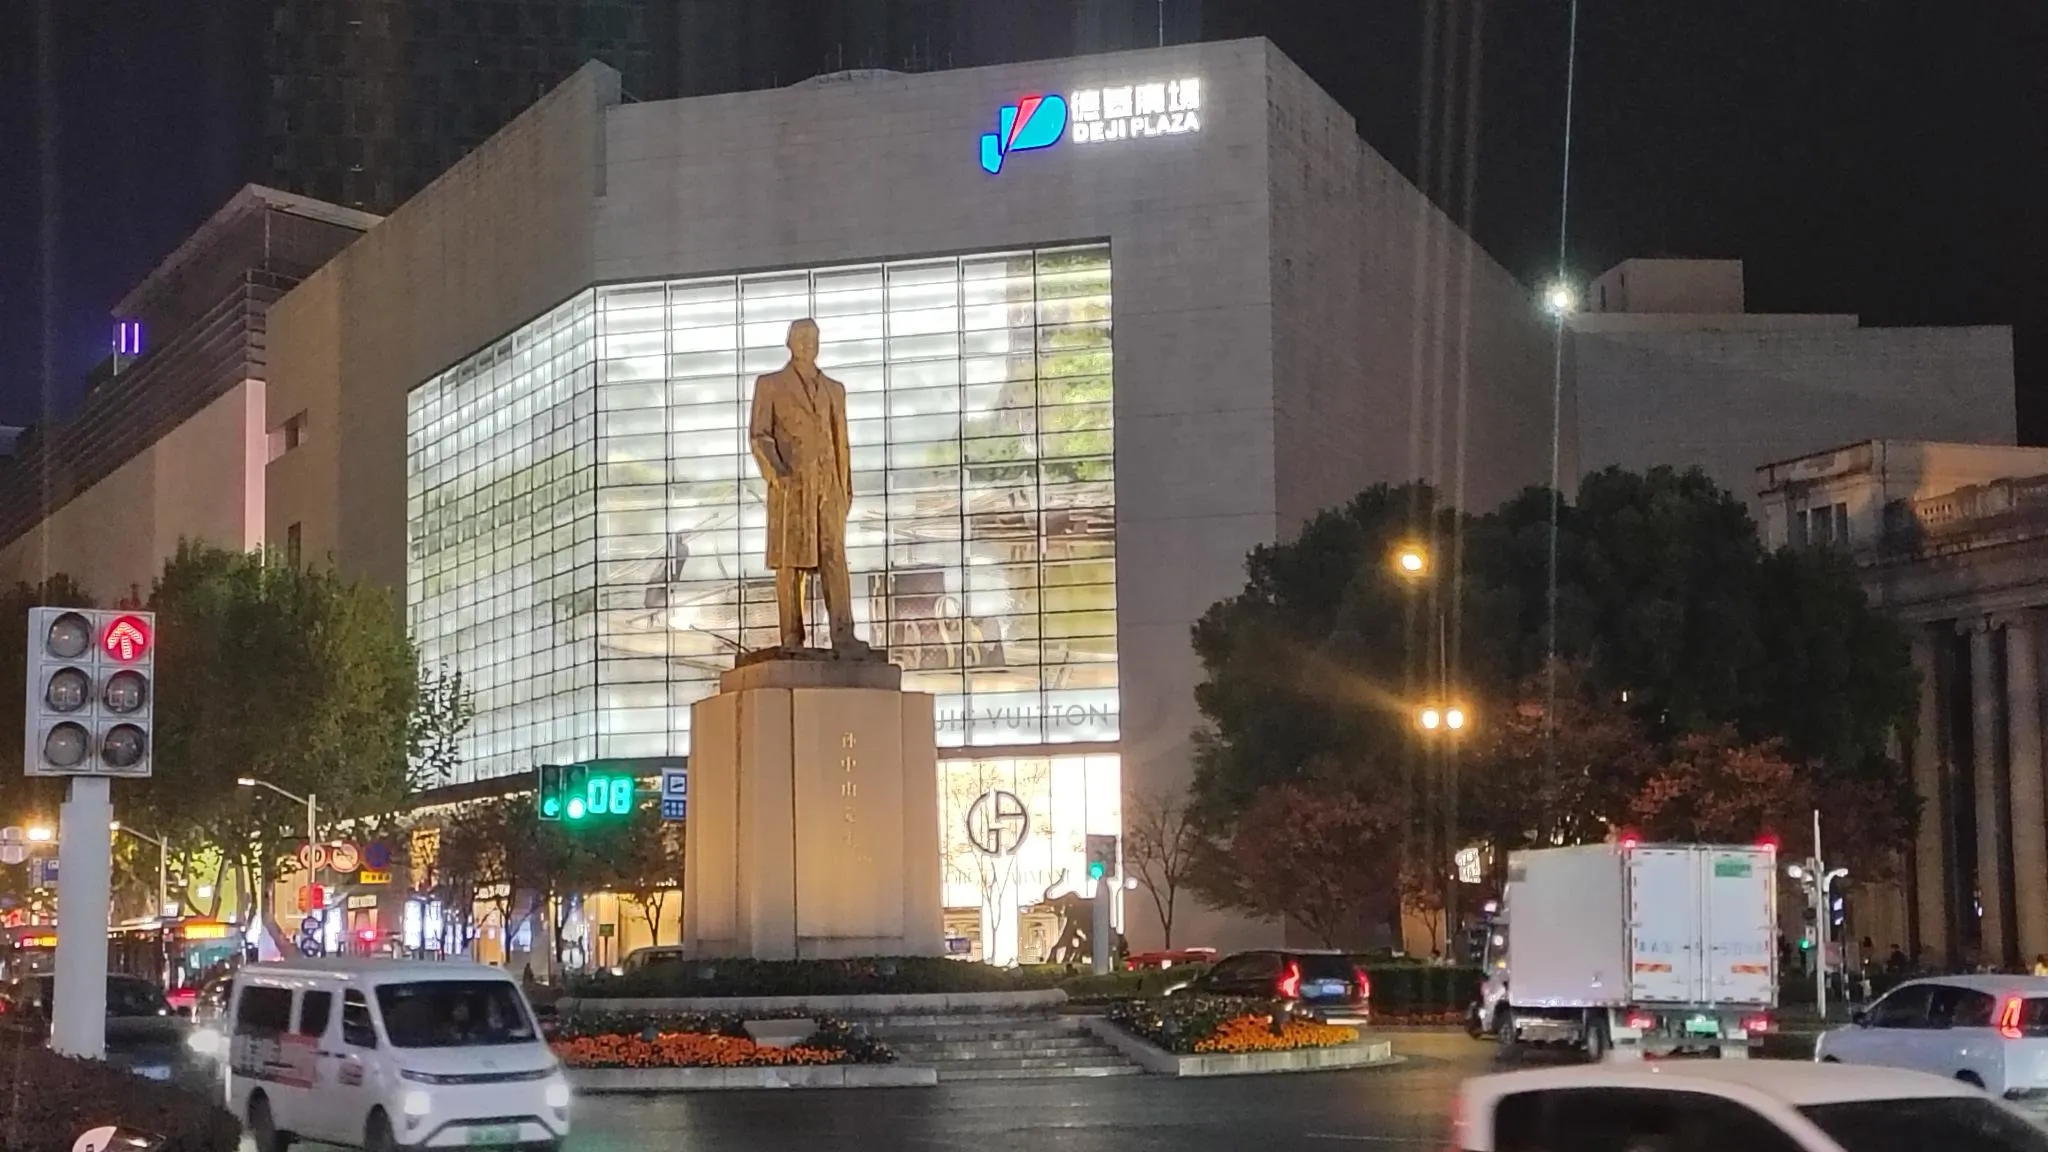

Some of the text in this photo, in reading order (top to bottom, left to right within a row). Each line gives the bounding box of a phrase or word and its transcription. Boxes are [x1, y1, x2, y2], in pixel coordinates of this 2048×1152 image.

[1073, 111, 1200, 143] DEJI PLAZA
[986, 703, 1108, 729] VUITTON
[587, 777, 633, 814] 08
